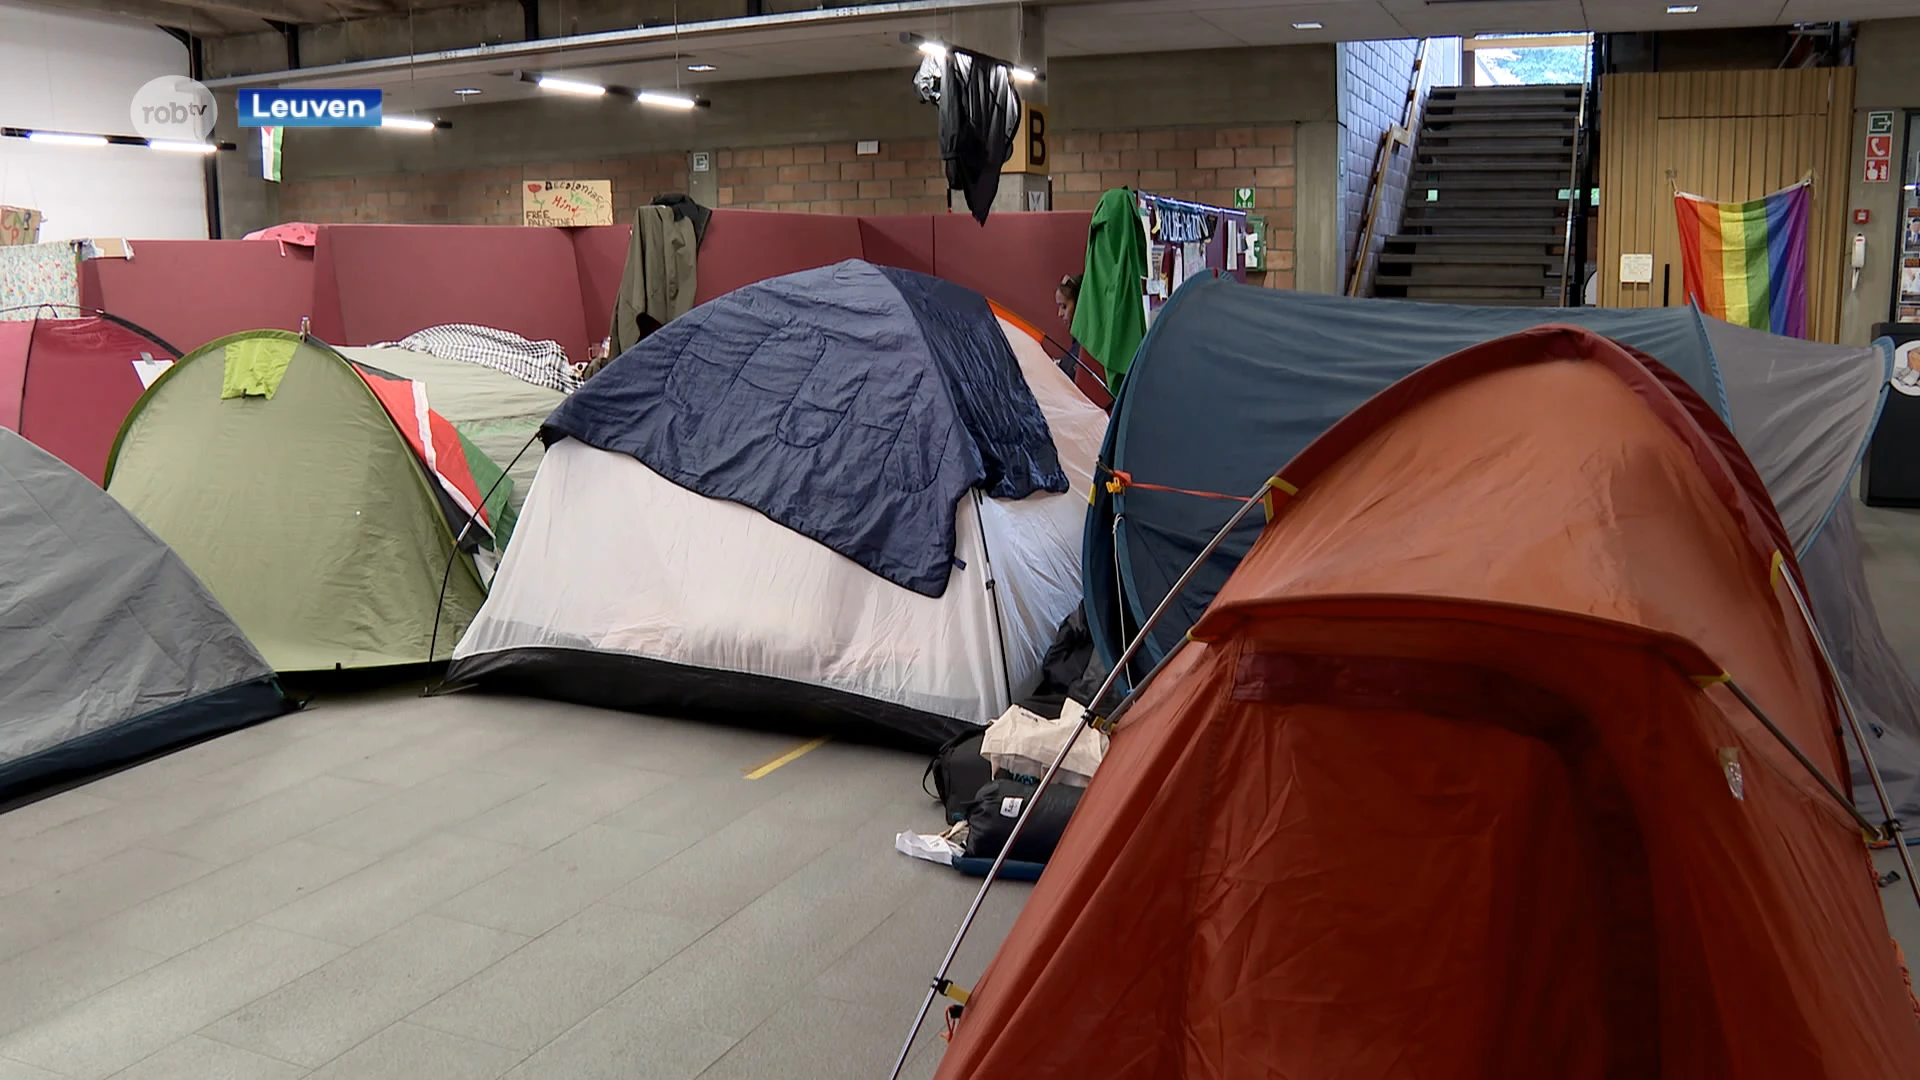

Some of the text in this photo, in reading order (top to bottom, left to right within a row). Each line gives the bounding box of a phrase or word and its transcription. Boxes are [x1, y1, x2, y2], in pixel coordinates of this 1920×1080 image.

[1029, 108, 1046, 167] B
[1236, 201, 1253, 209] AED
[526, 210, 549, 219] FREE
